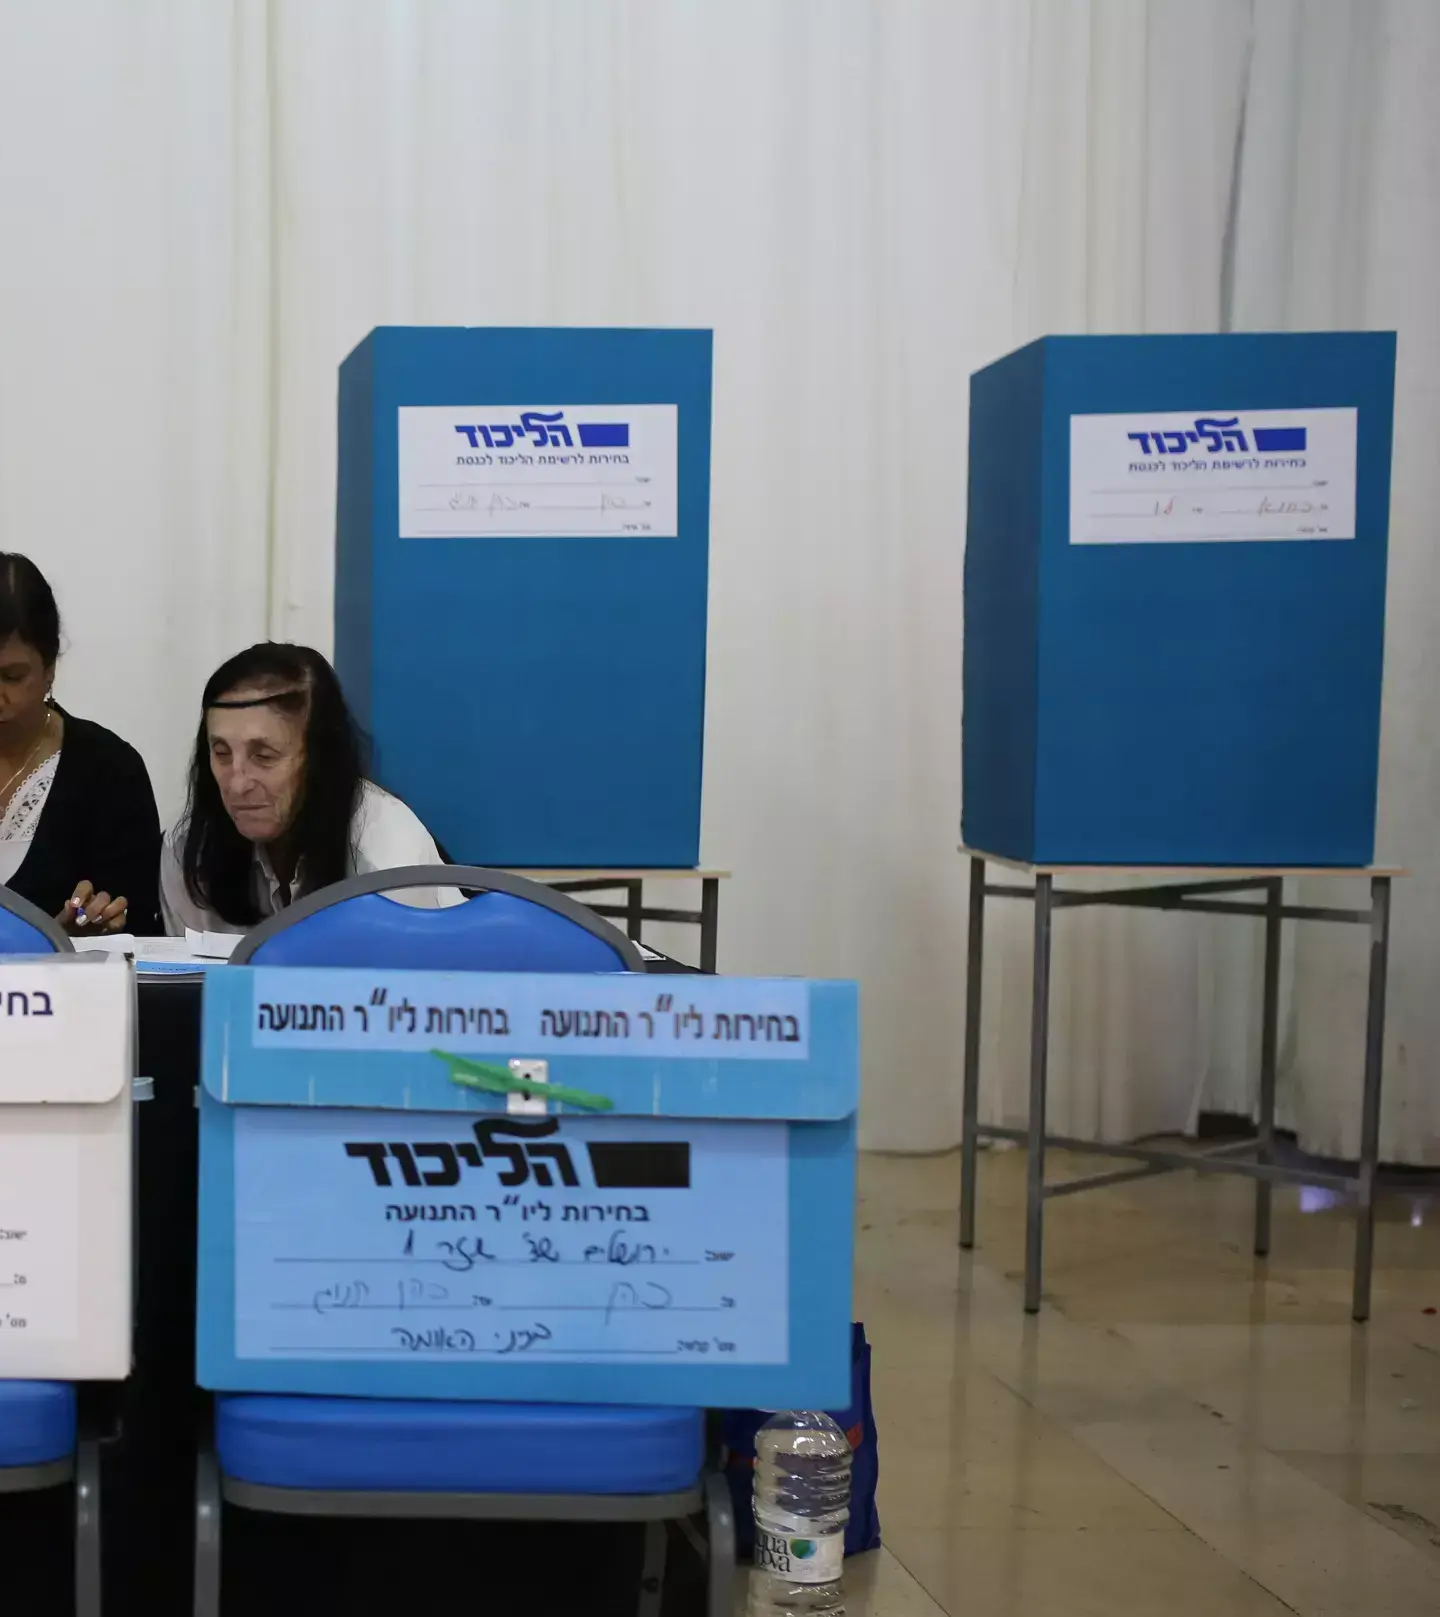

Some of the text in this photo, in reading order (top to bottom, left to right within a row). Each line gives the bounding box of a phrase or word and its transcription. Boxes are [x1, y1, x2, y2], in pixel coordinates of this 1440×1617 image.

[454, 411, 574, 448] הליכוד
[1127, 417, 1249, 454] הליכוד
[456, 453, 630, 467] בחירות לרשימת הליכוד לכנסת
[259, 1002, 345, 1031] התנועה
[425, 1006, 510, 1035] בחירות
[540, 1009, 630, 1038] התנועה
[713, 1013, 800, 1042] בחירות
[343, 1117, 581, 1188] הליכוד
[385, 1204, 476, 1222] התנועה
[561, 1204, 650, 1222] בחירות
